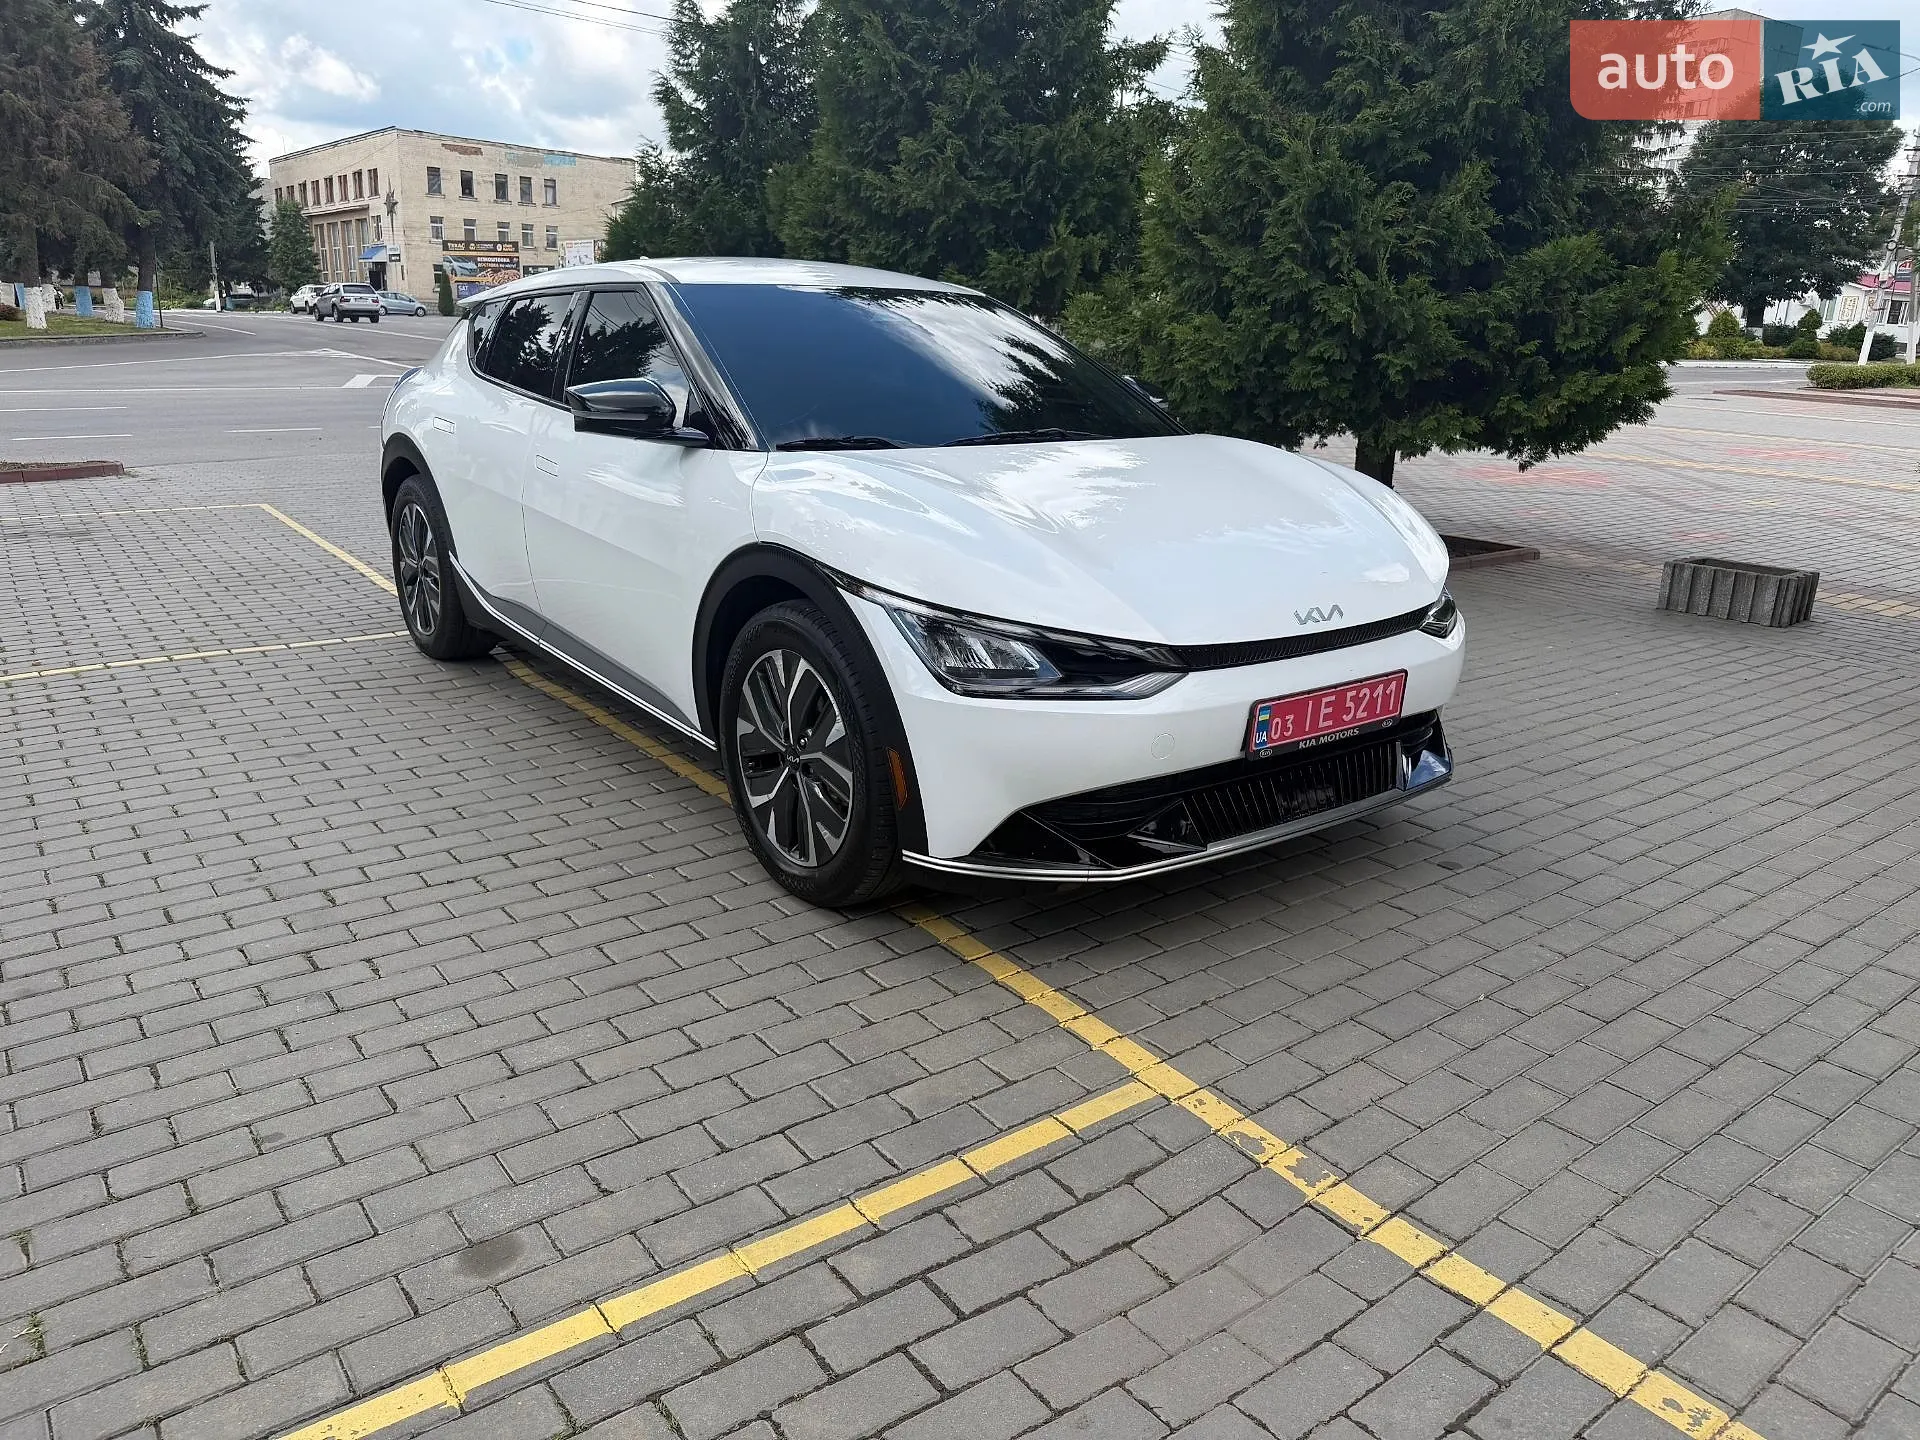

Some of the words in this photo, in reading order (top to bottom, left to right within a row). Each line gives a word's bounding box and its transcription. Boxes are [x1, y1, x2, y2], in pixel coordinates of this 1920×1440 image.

[1294, 604, 1344, 625] KIA
[1271, 714, 1294, 740] 03
[1305, 696, 1336, 731] IE
[1342, 681, 1397, 722] 5211
[1255, 731, 1268, 744] UA
[1298, 738, 1317, 749] KIA
[1318, 727, 1360, 745] MOTORS
